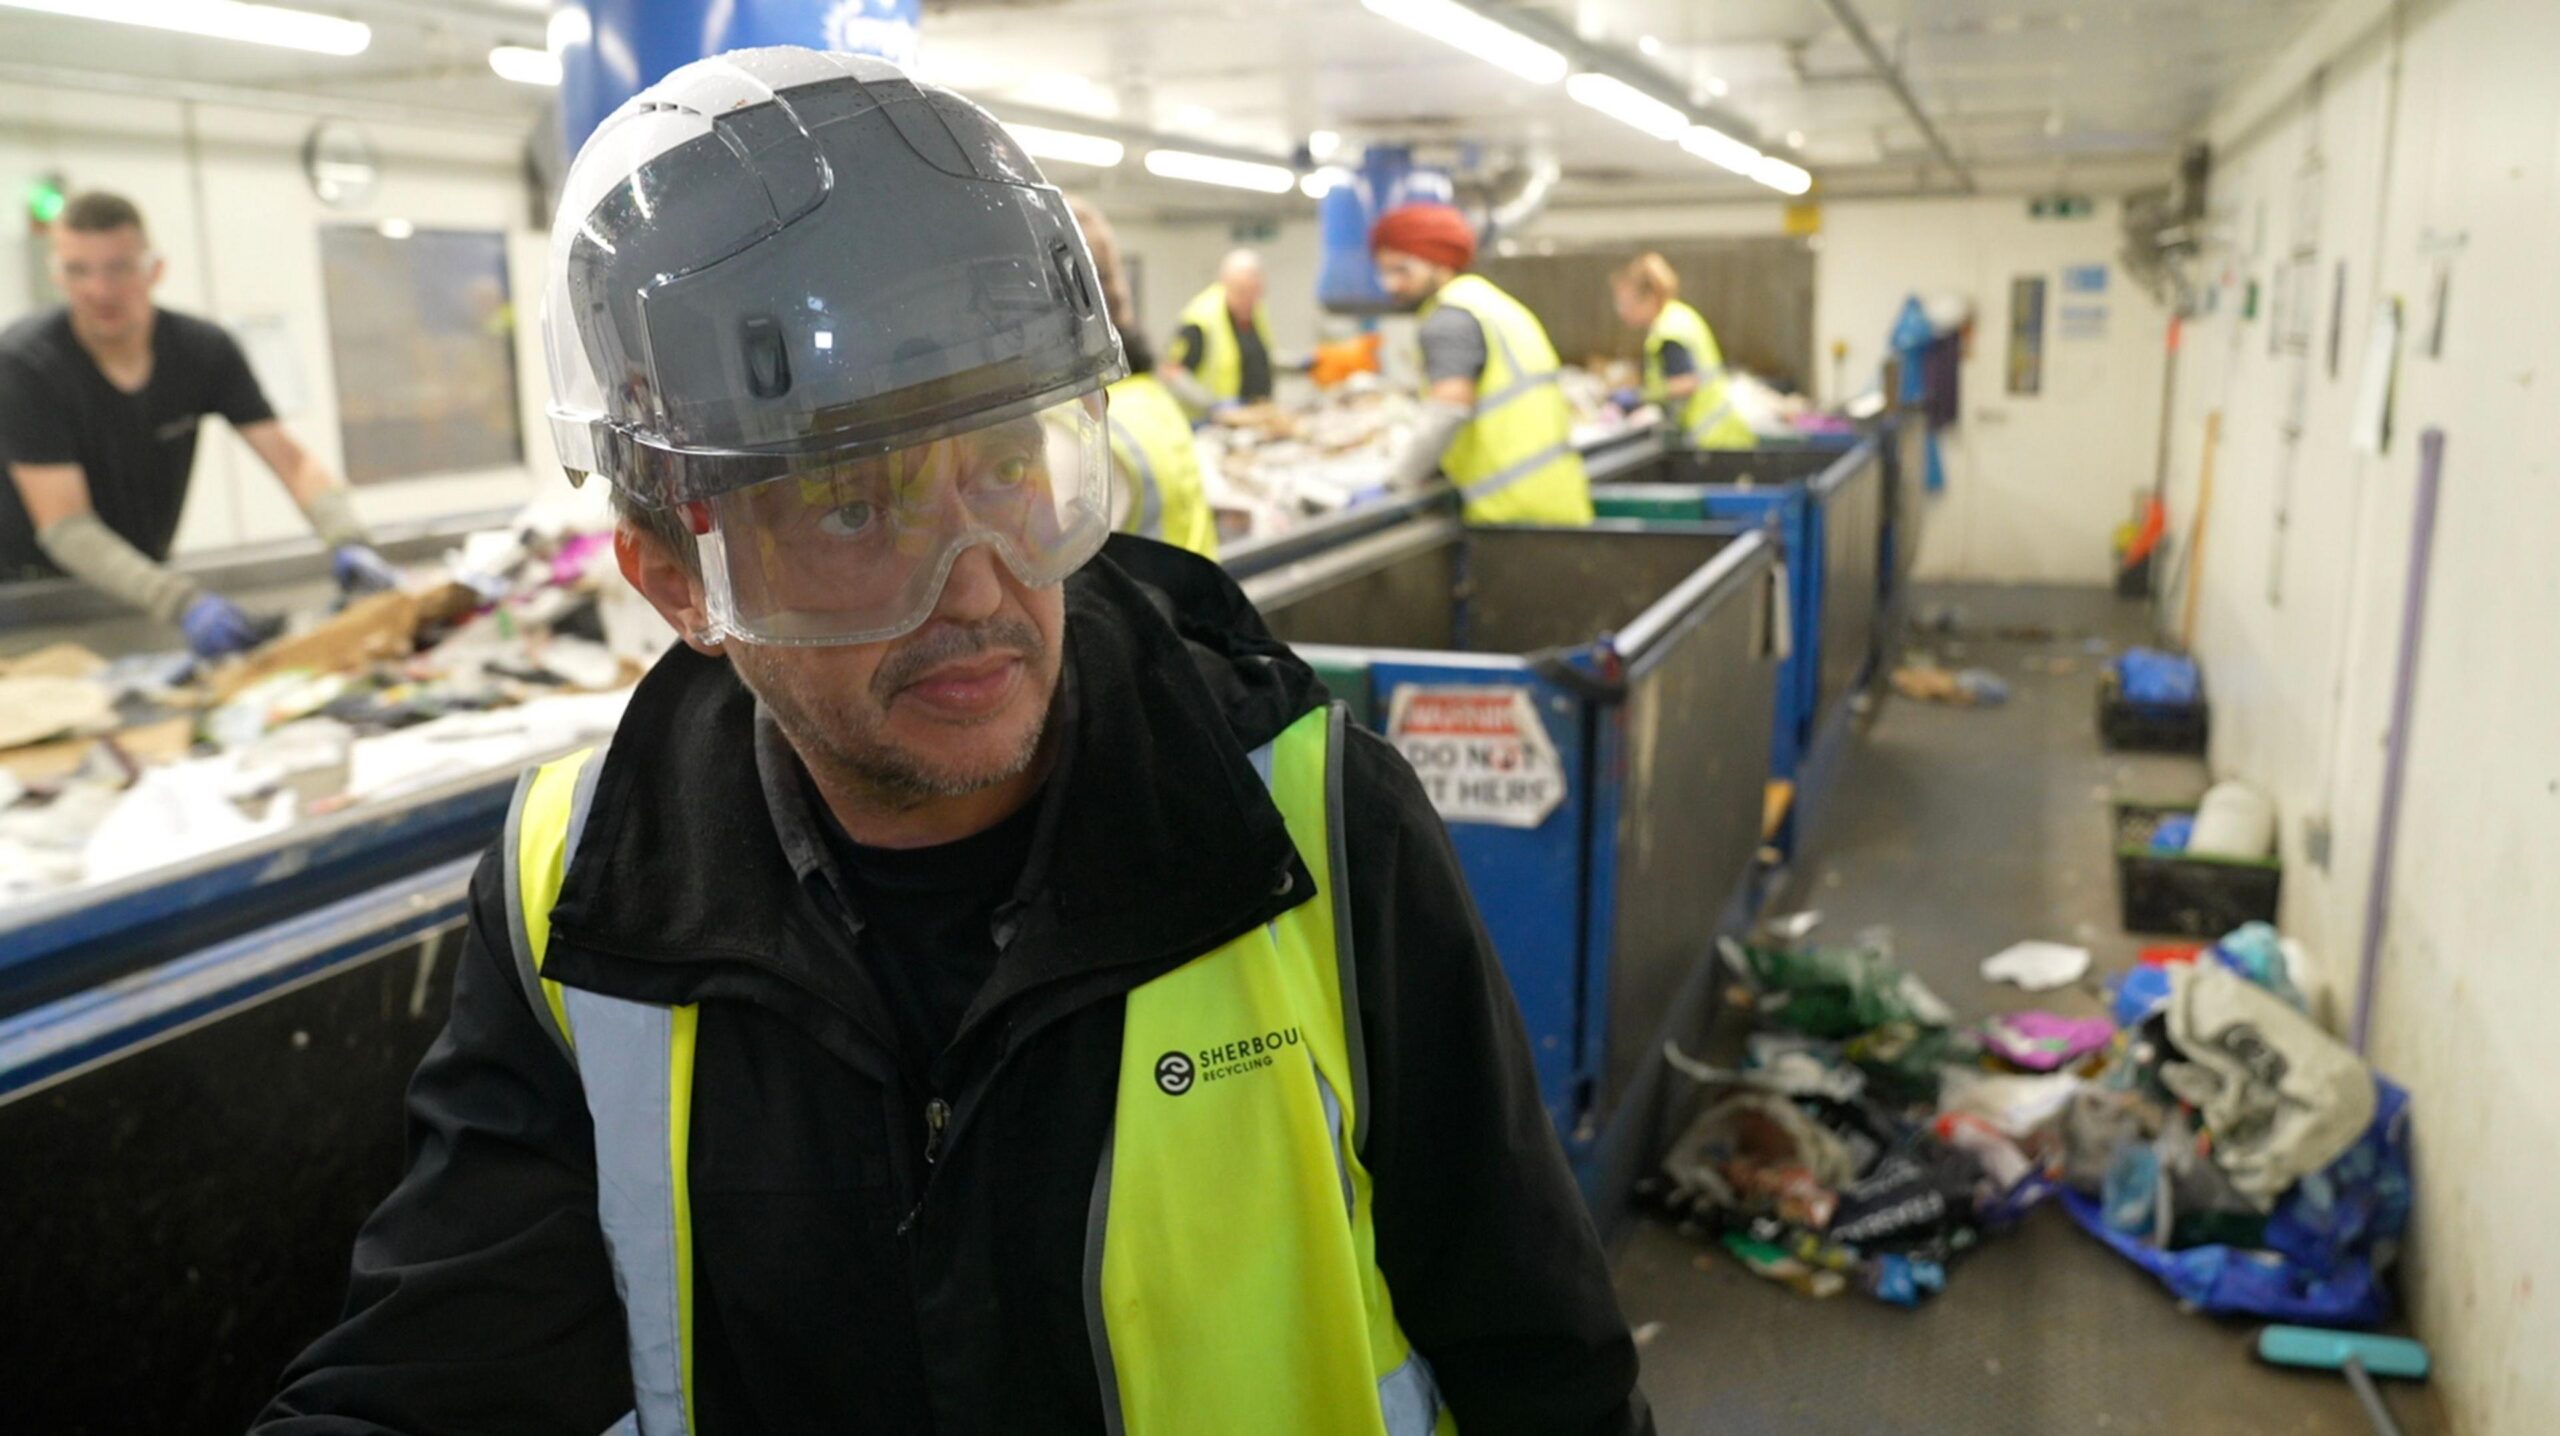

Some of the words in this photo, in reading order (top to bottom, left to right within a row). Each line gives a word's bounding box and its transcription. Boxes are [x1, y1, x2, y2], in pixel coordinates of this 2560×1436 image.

[1408, 741, 1457, 769] DO
[1199, 1027, 1300, 1068] SHERBOU
[1203, 1056, 1273, 1082] RECYCLING
